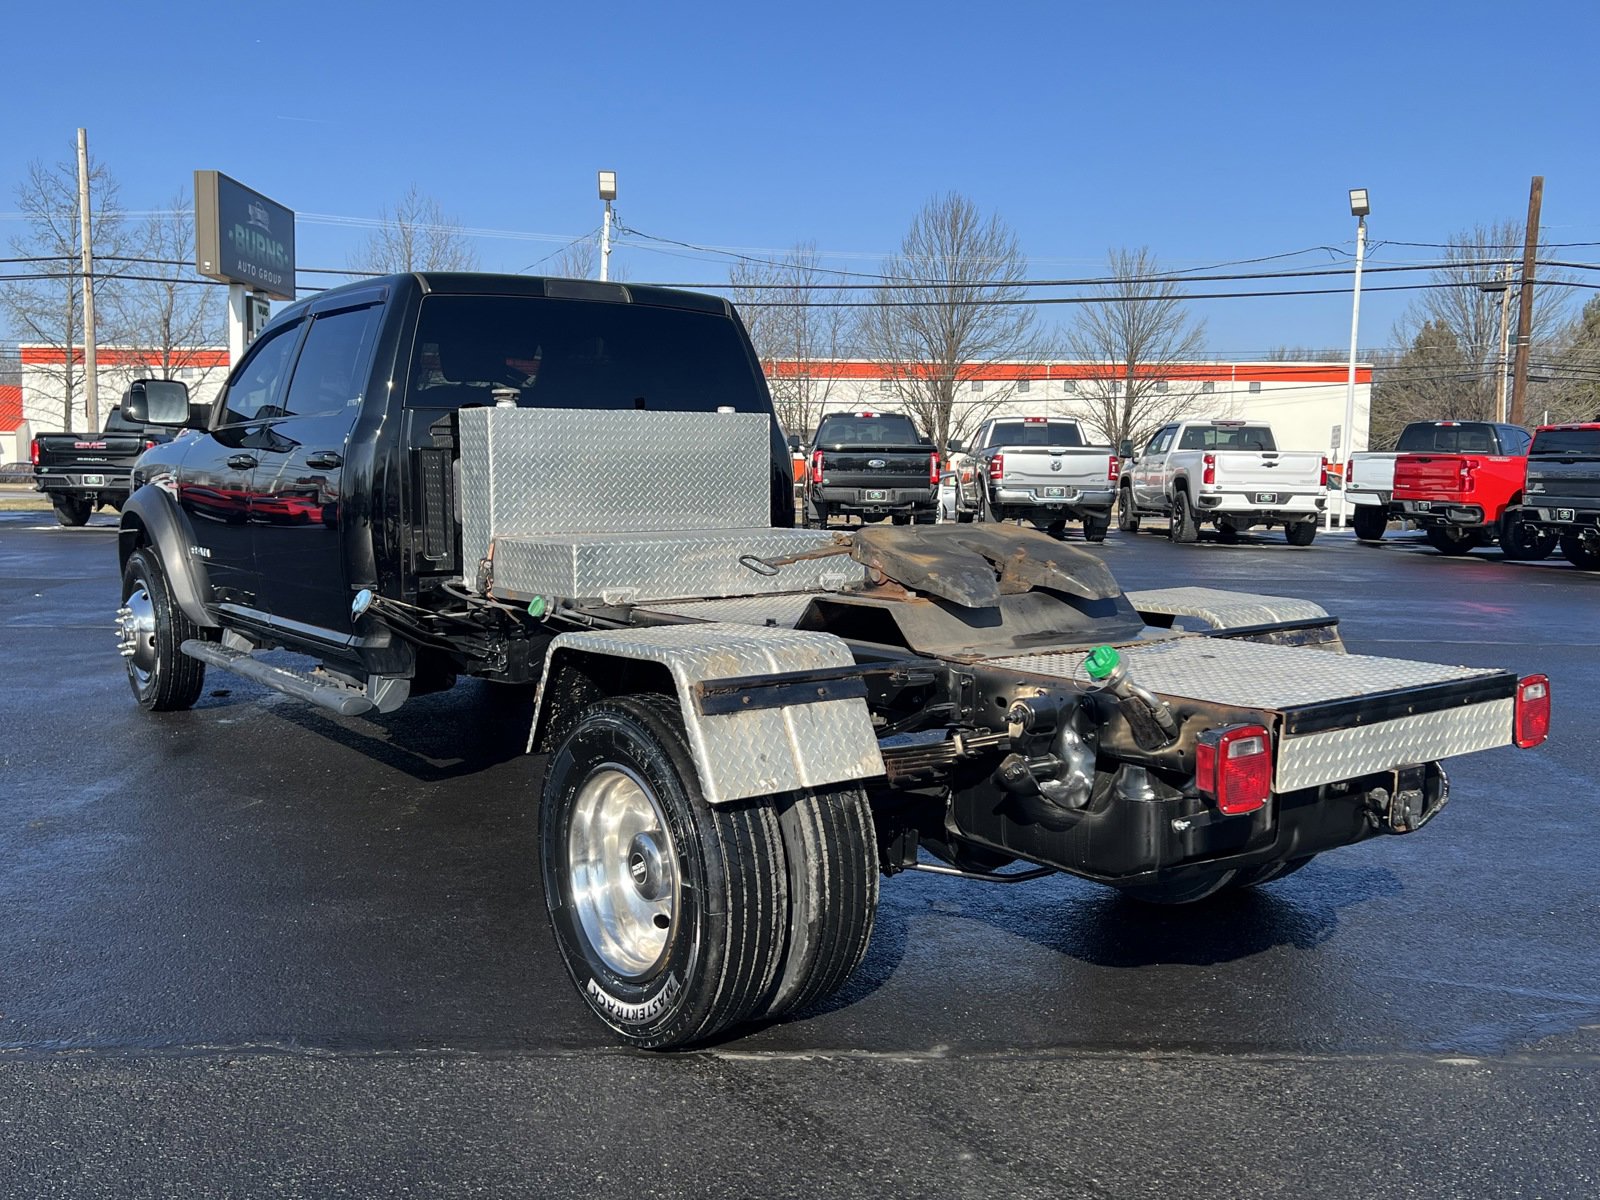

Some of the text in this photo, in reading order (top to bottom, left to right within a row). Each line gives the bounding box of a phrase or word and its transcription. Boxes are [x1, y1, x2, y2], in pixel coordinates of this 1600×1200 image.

[235, 223, 284, 268] BURNS
[237, 260, 282, 285] AUTO GROUP
[591, 980, 675, 1020] MASTERTRACK
